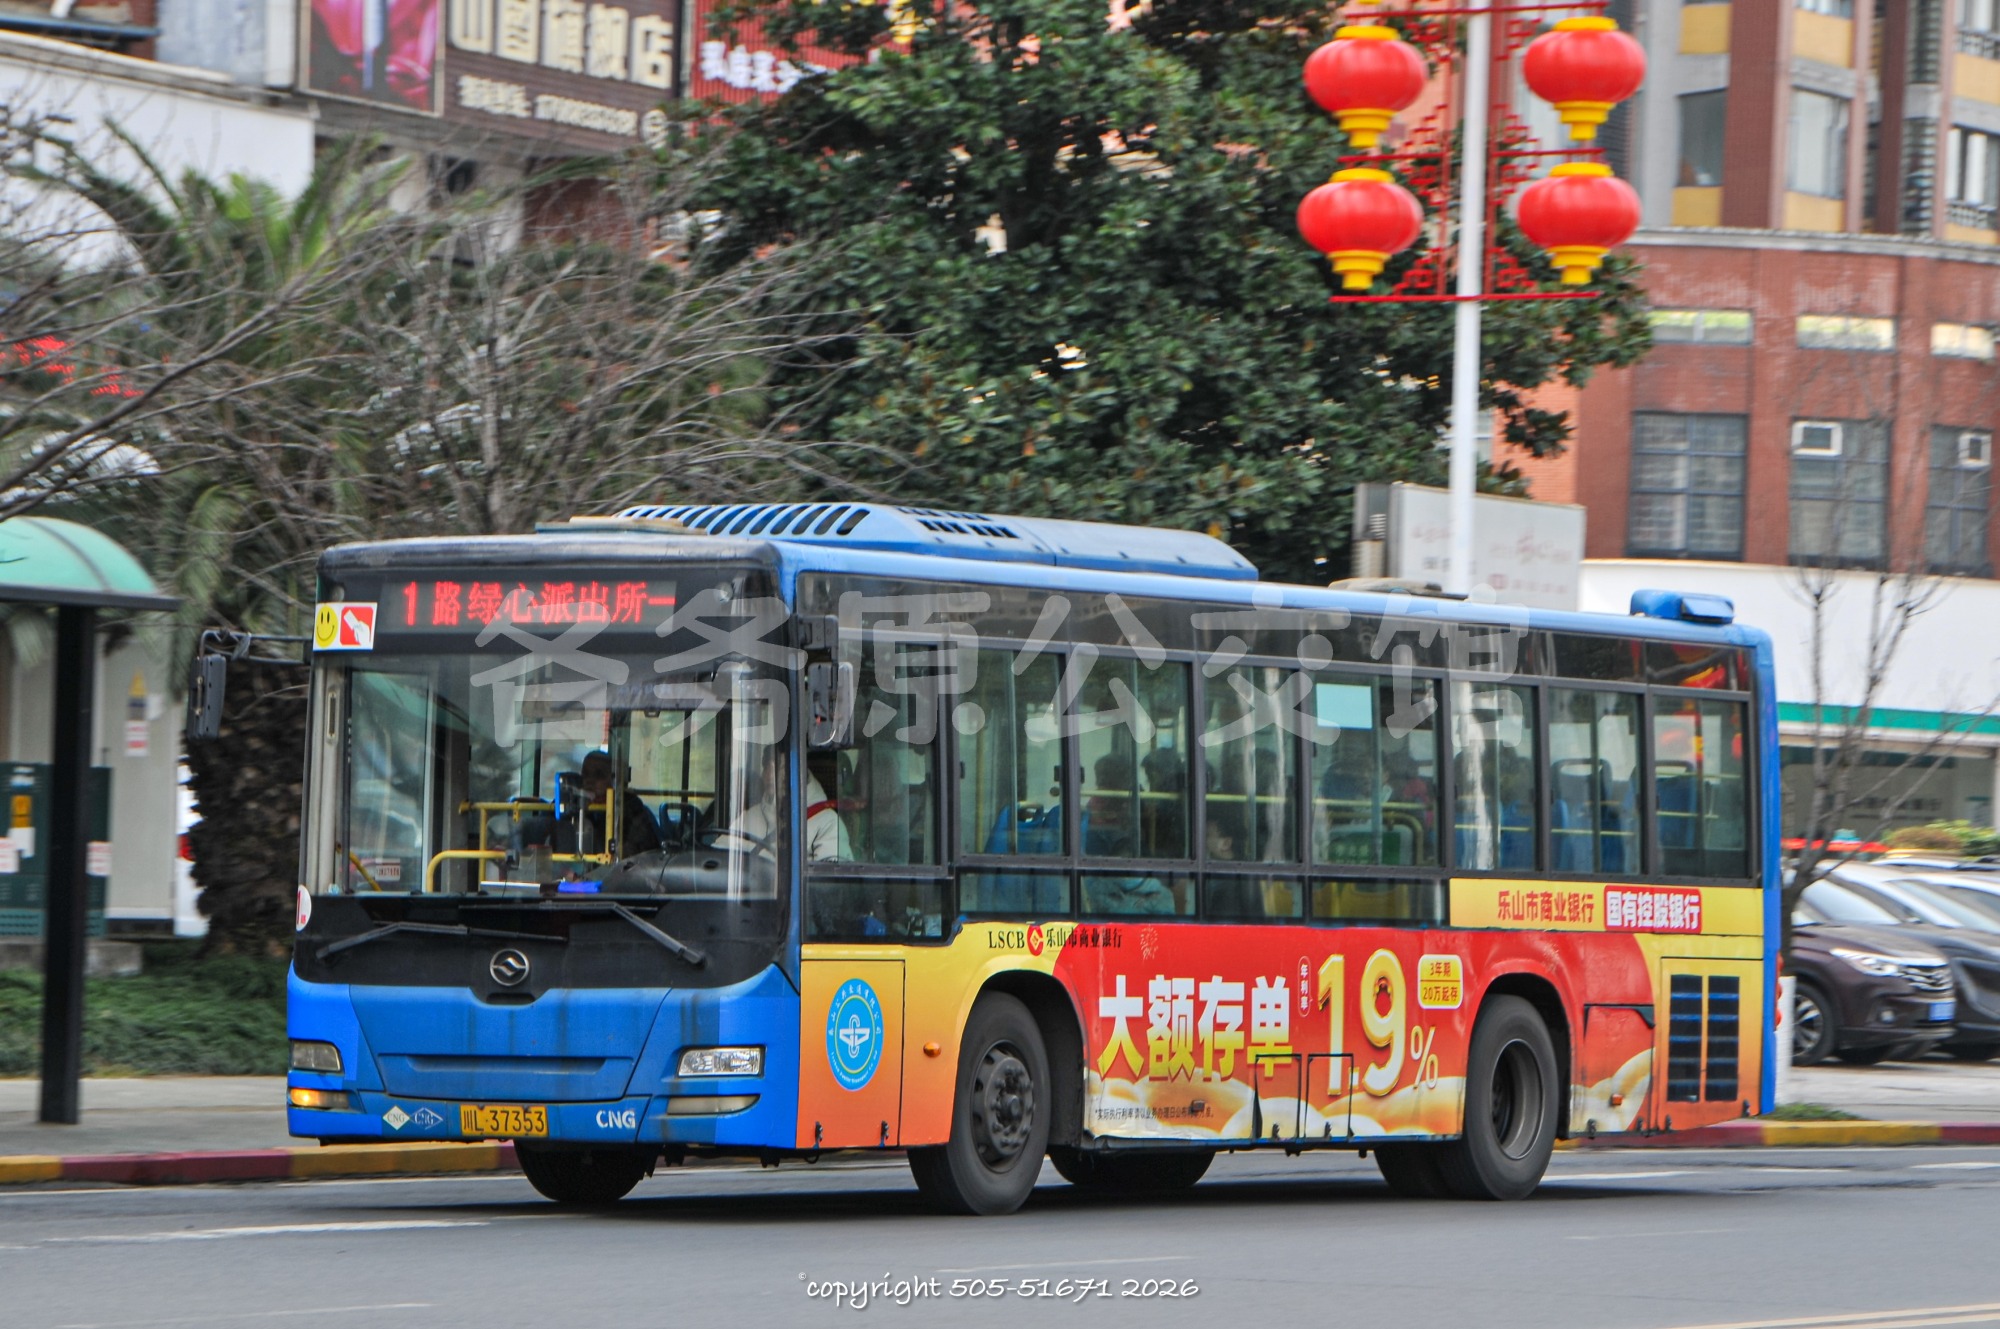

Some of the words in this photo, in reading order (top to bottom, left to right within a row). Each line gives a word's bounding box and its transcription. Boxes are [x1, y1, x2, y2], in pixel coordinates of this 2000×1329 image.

[1498, 890, 1594, 923] 乐山市商业银行
[1606, 890, 1700, 929] 国有控股银行
[988, 931, 1025, 949] LSCB
[1046, 927, 1122, 948] 乐山市商业银行
[1097, 974, 1293, 1084] 大额存单
[596, 1110, 636, 1129] CNG
